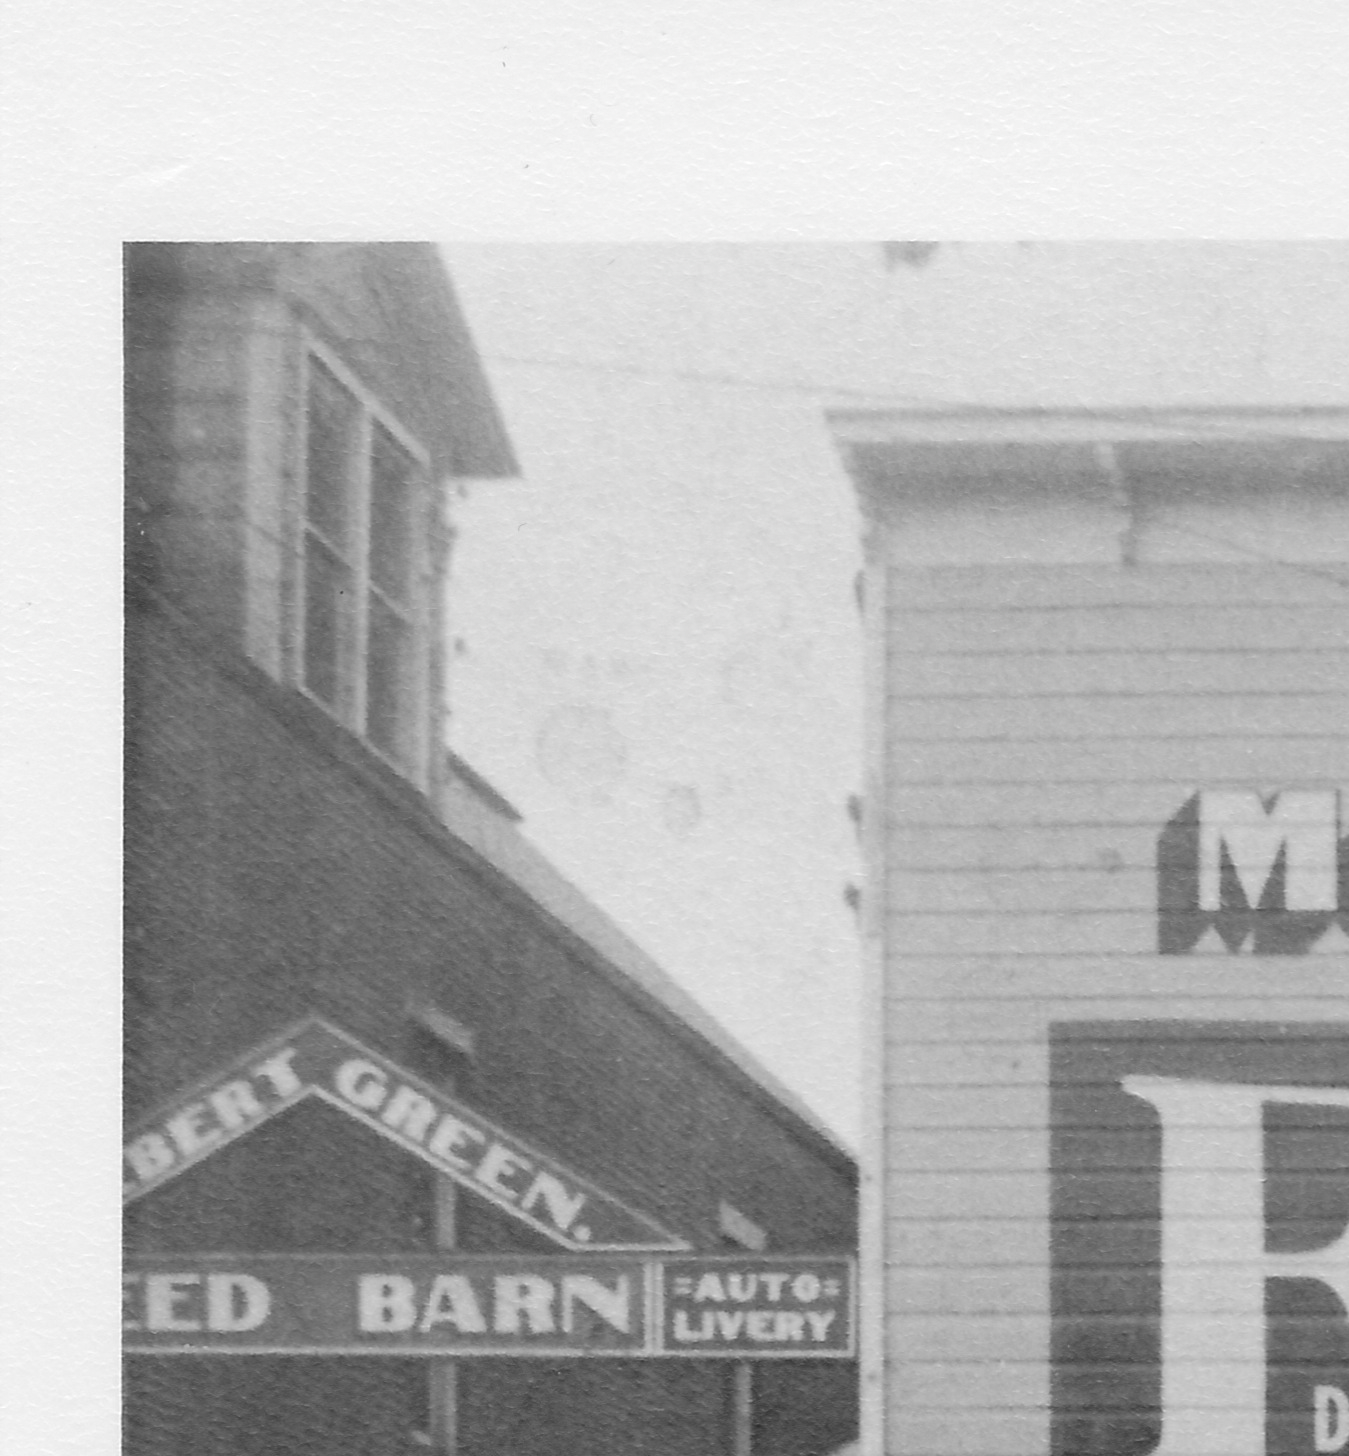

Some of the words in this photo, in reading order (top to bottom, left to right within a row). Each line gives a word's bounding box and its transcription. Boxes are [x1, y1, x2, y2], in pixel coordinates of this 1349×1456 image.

[124, 1048, 298, 1196] BERT
[334, 1058, 592, 1243] GREEN.
[357, 1273, 631, 1334] BARN
[673, 1310, 836, 1342] LIVERY
